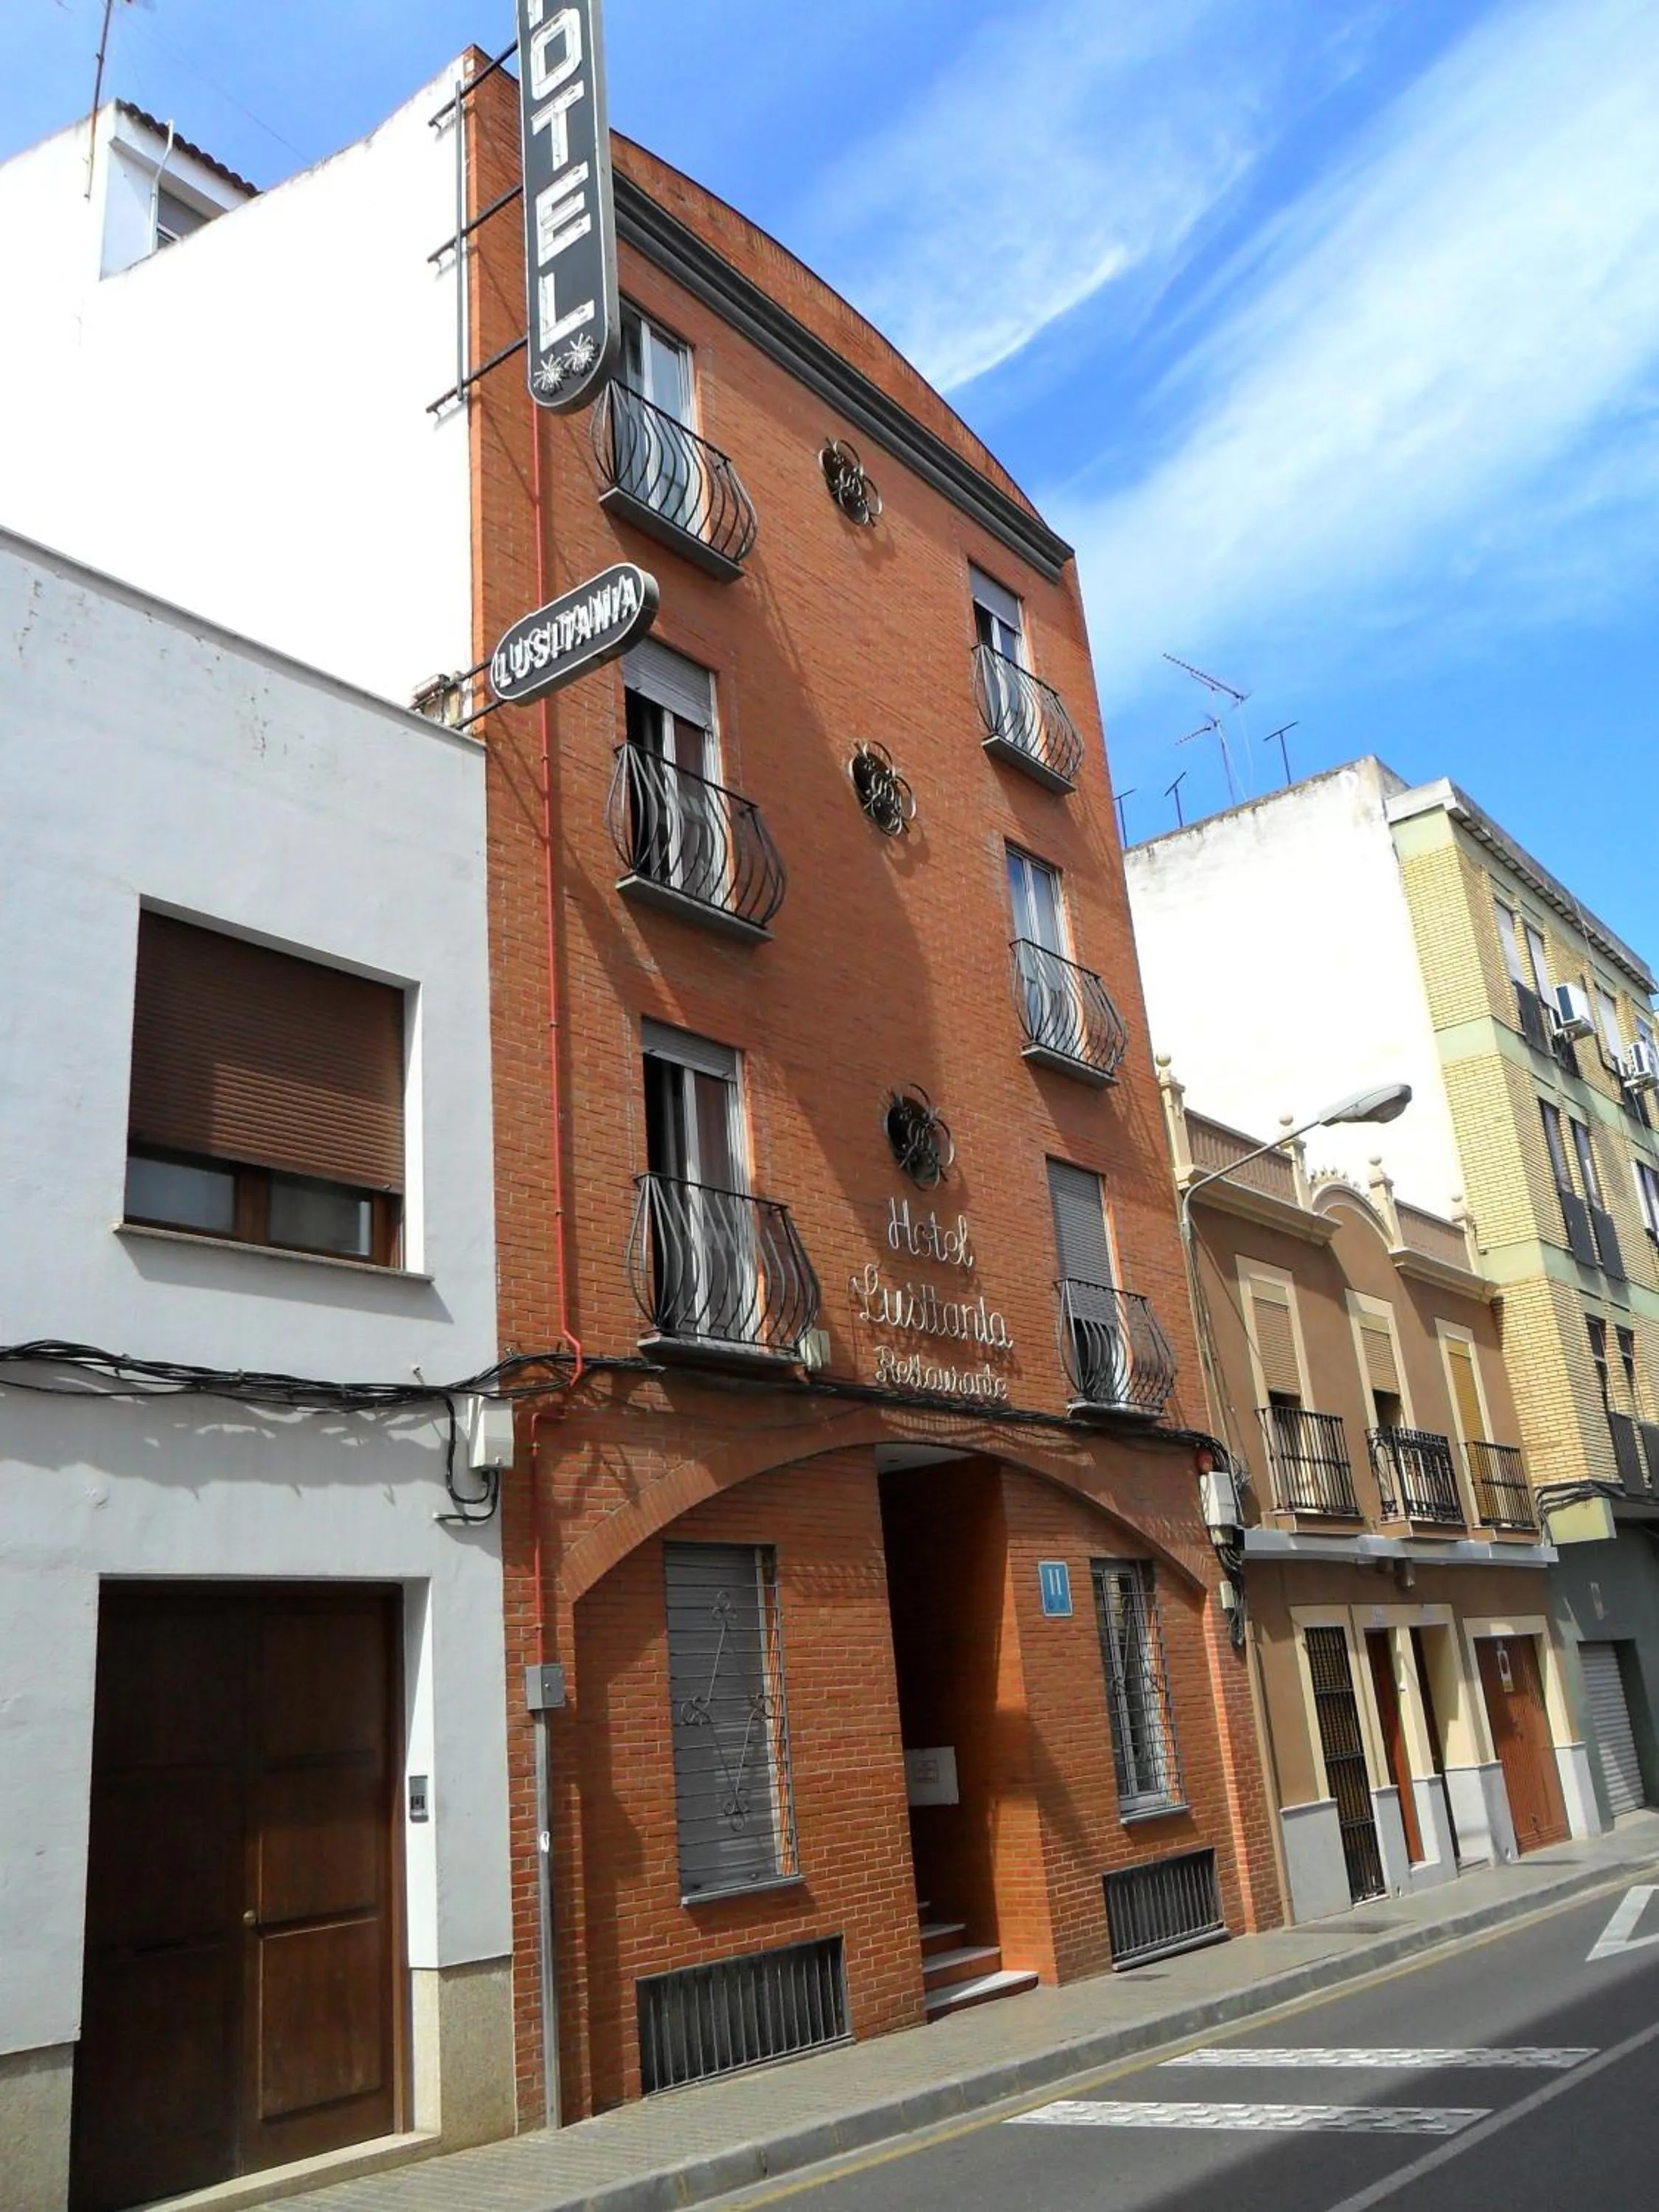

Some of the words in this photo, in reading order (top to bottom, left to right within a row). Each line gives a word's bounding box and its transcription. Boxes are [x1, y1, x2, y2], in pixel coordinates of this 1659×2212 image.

[493, 574, 637, 688] LUSITANIA
[888, 1197, 974, 1267] Hotel
[873, 1346, 1009, 1400] Restaurante
